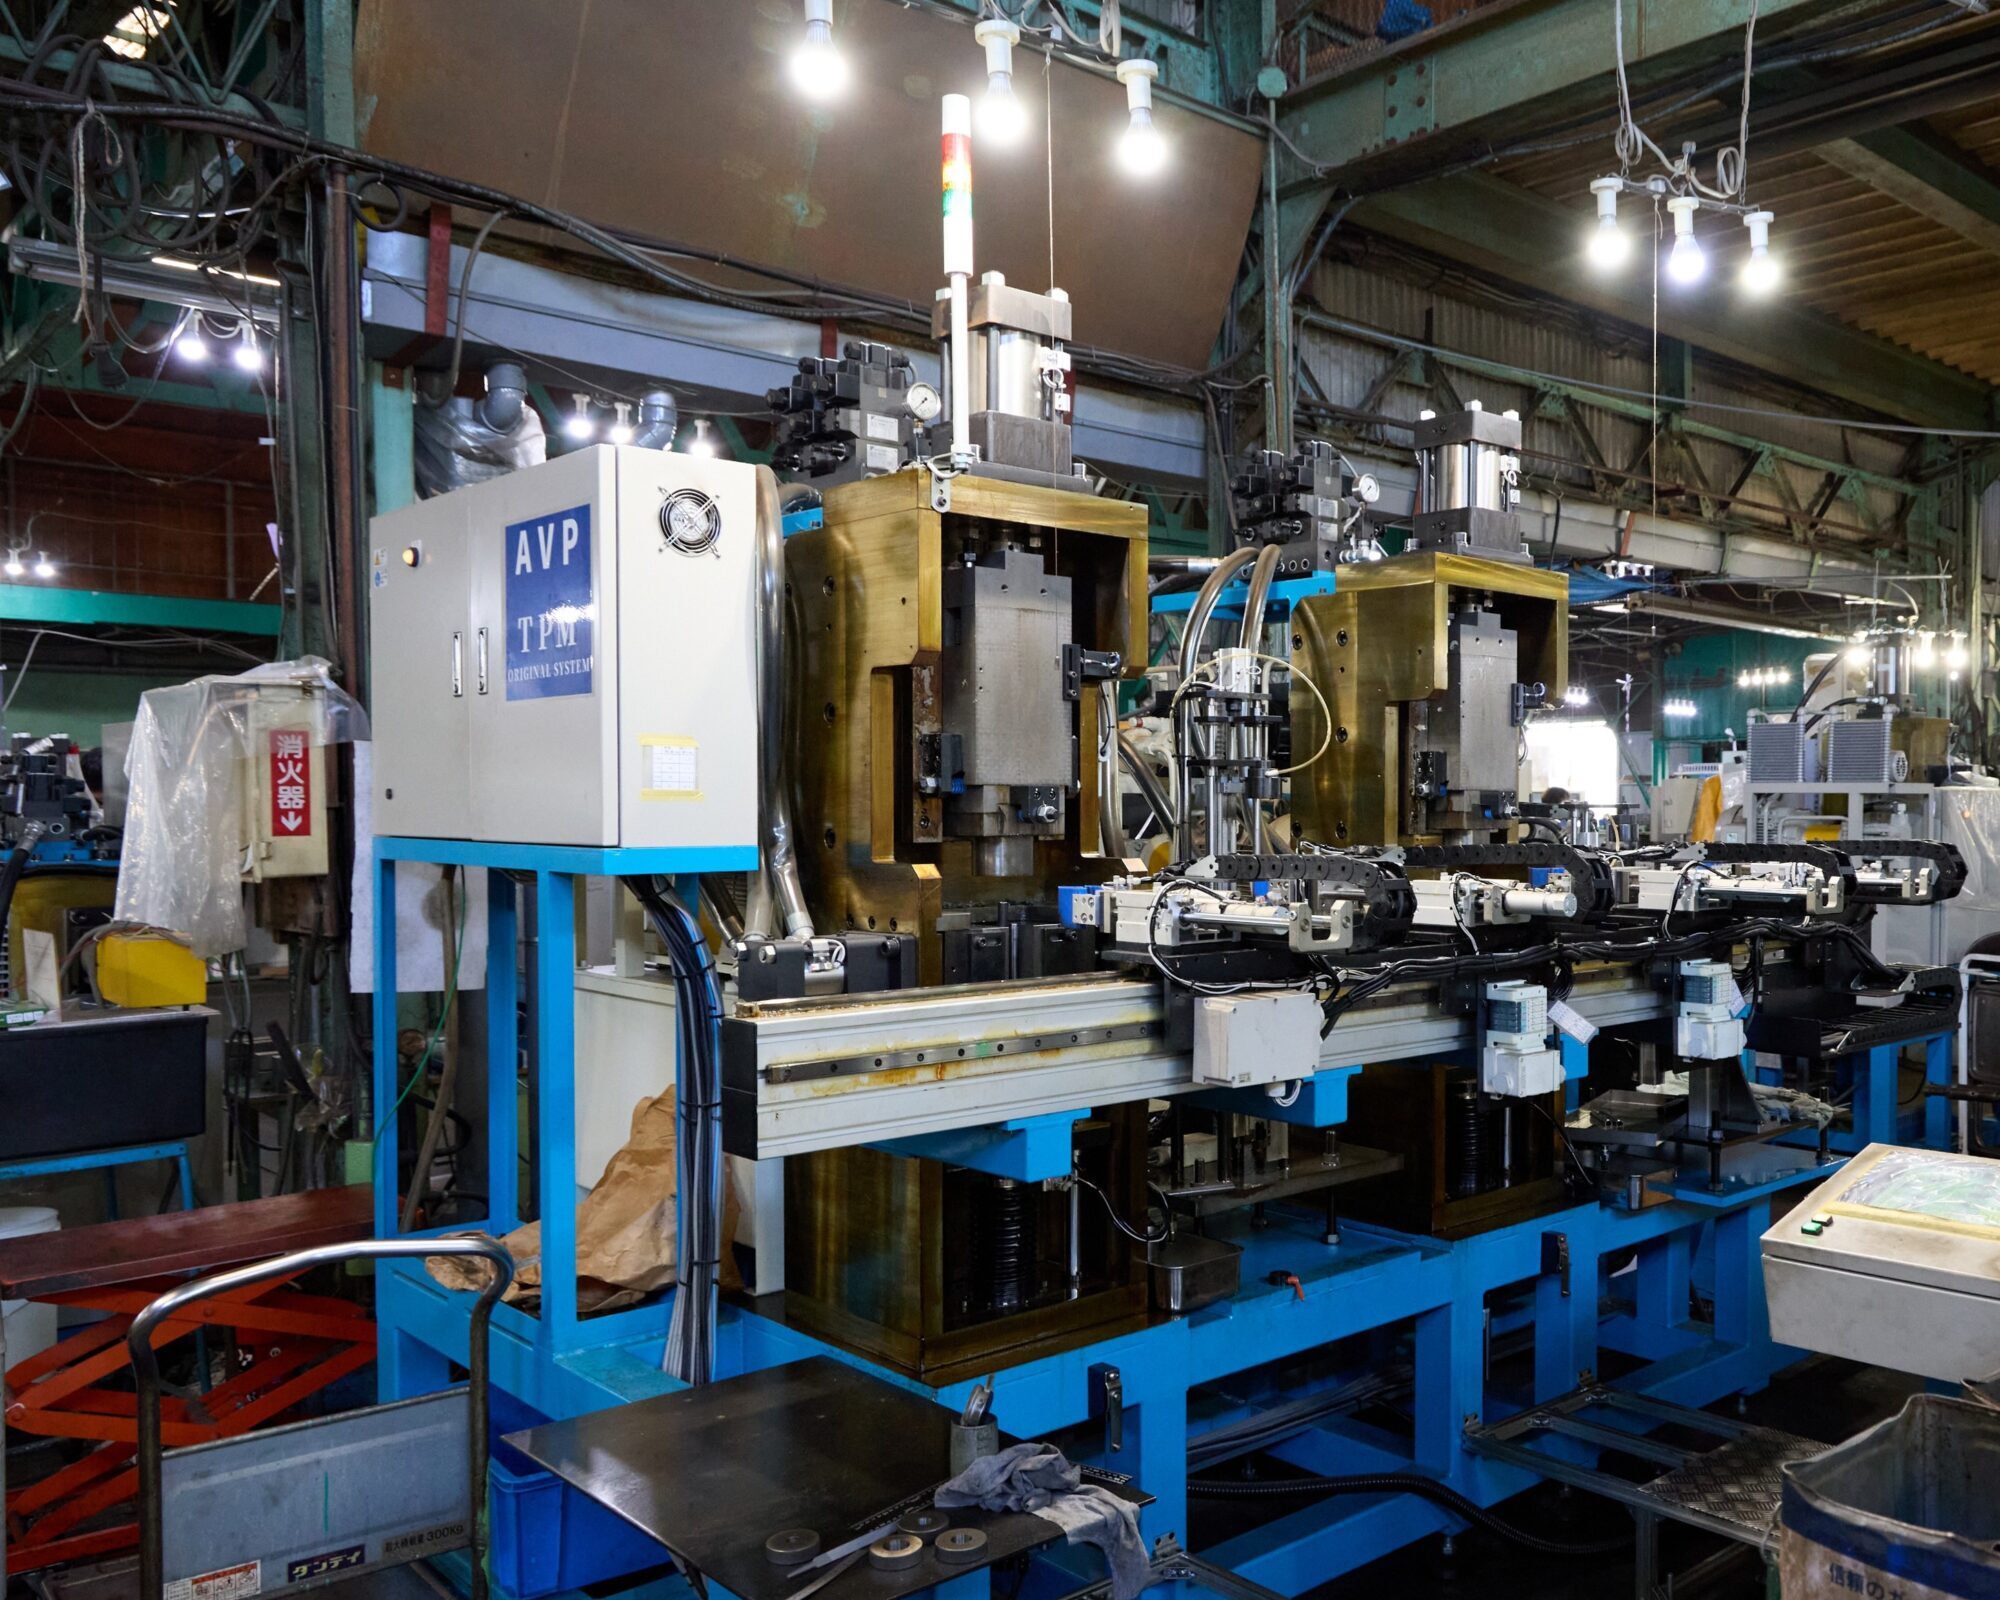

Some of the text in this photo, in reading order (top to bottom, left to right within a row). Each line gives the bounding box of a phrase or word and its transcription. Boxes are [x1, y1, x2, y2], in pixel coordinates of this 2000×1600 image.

[514, 518, 579, 576] AVP
[517, 612, 577, 653] TPM
[507, 658, 591, 683] ORIGINAL SYSTEM
[277, 734, 306, 810] 消火器
